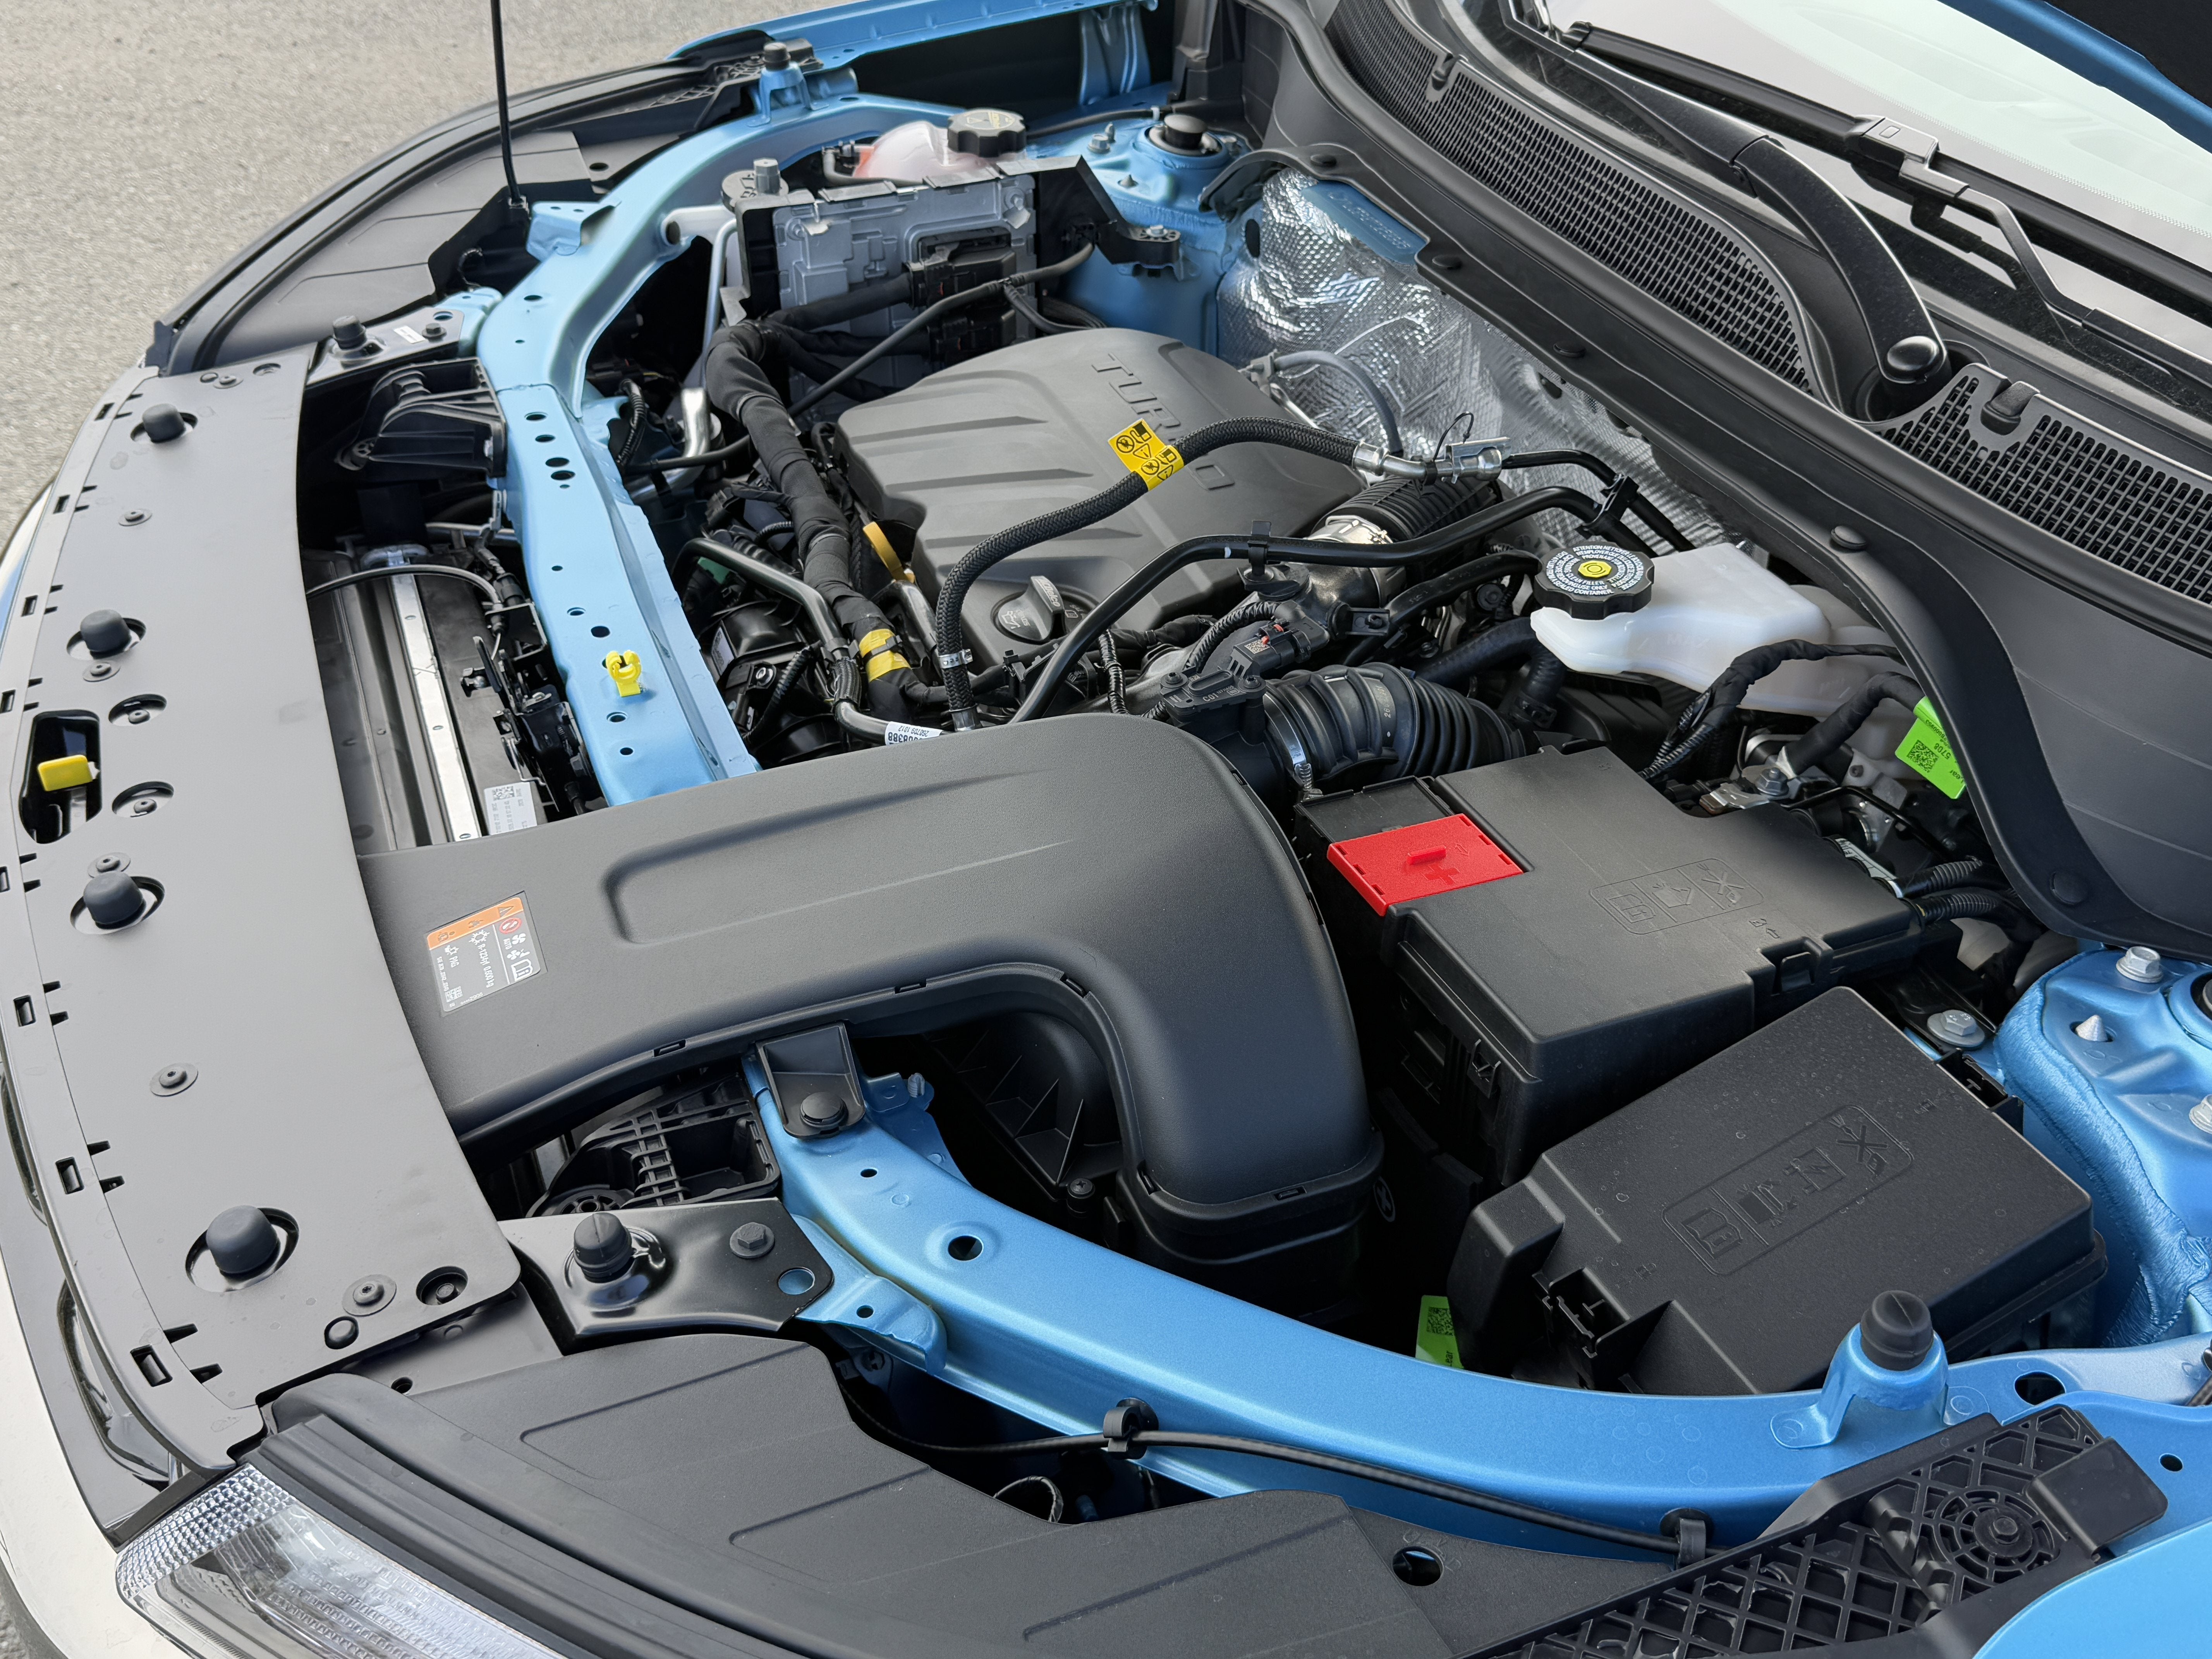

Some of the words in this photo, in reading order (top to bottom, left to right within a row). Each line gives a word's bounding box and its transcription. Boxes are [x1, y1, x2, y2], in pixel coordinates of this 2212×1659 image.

[1091, 352, 1236, 491] TURO
[1546, 559, 1557, 569] FLUID
[1546, 569, 1556, 579] FROM
[1556, 573, 1579, 587] REMOVING
[1566, 573, 1583, 583] CLEAN
[1553, 580, 1575, 592] SEALED
[1933, 742, 1951, 760] 5708
[503, 938, 513, 950] AUTO
[449, 956, 460, 968] PAG
[486, 980, 495, 989] kg
